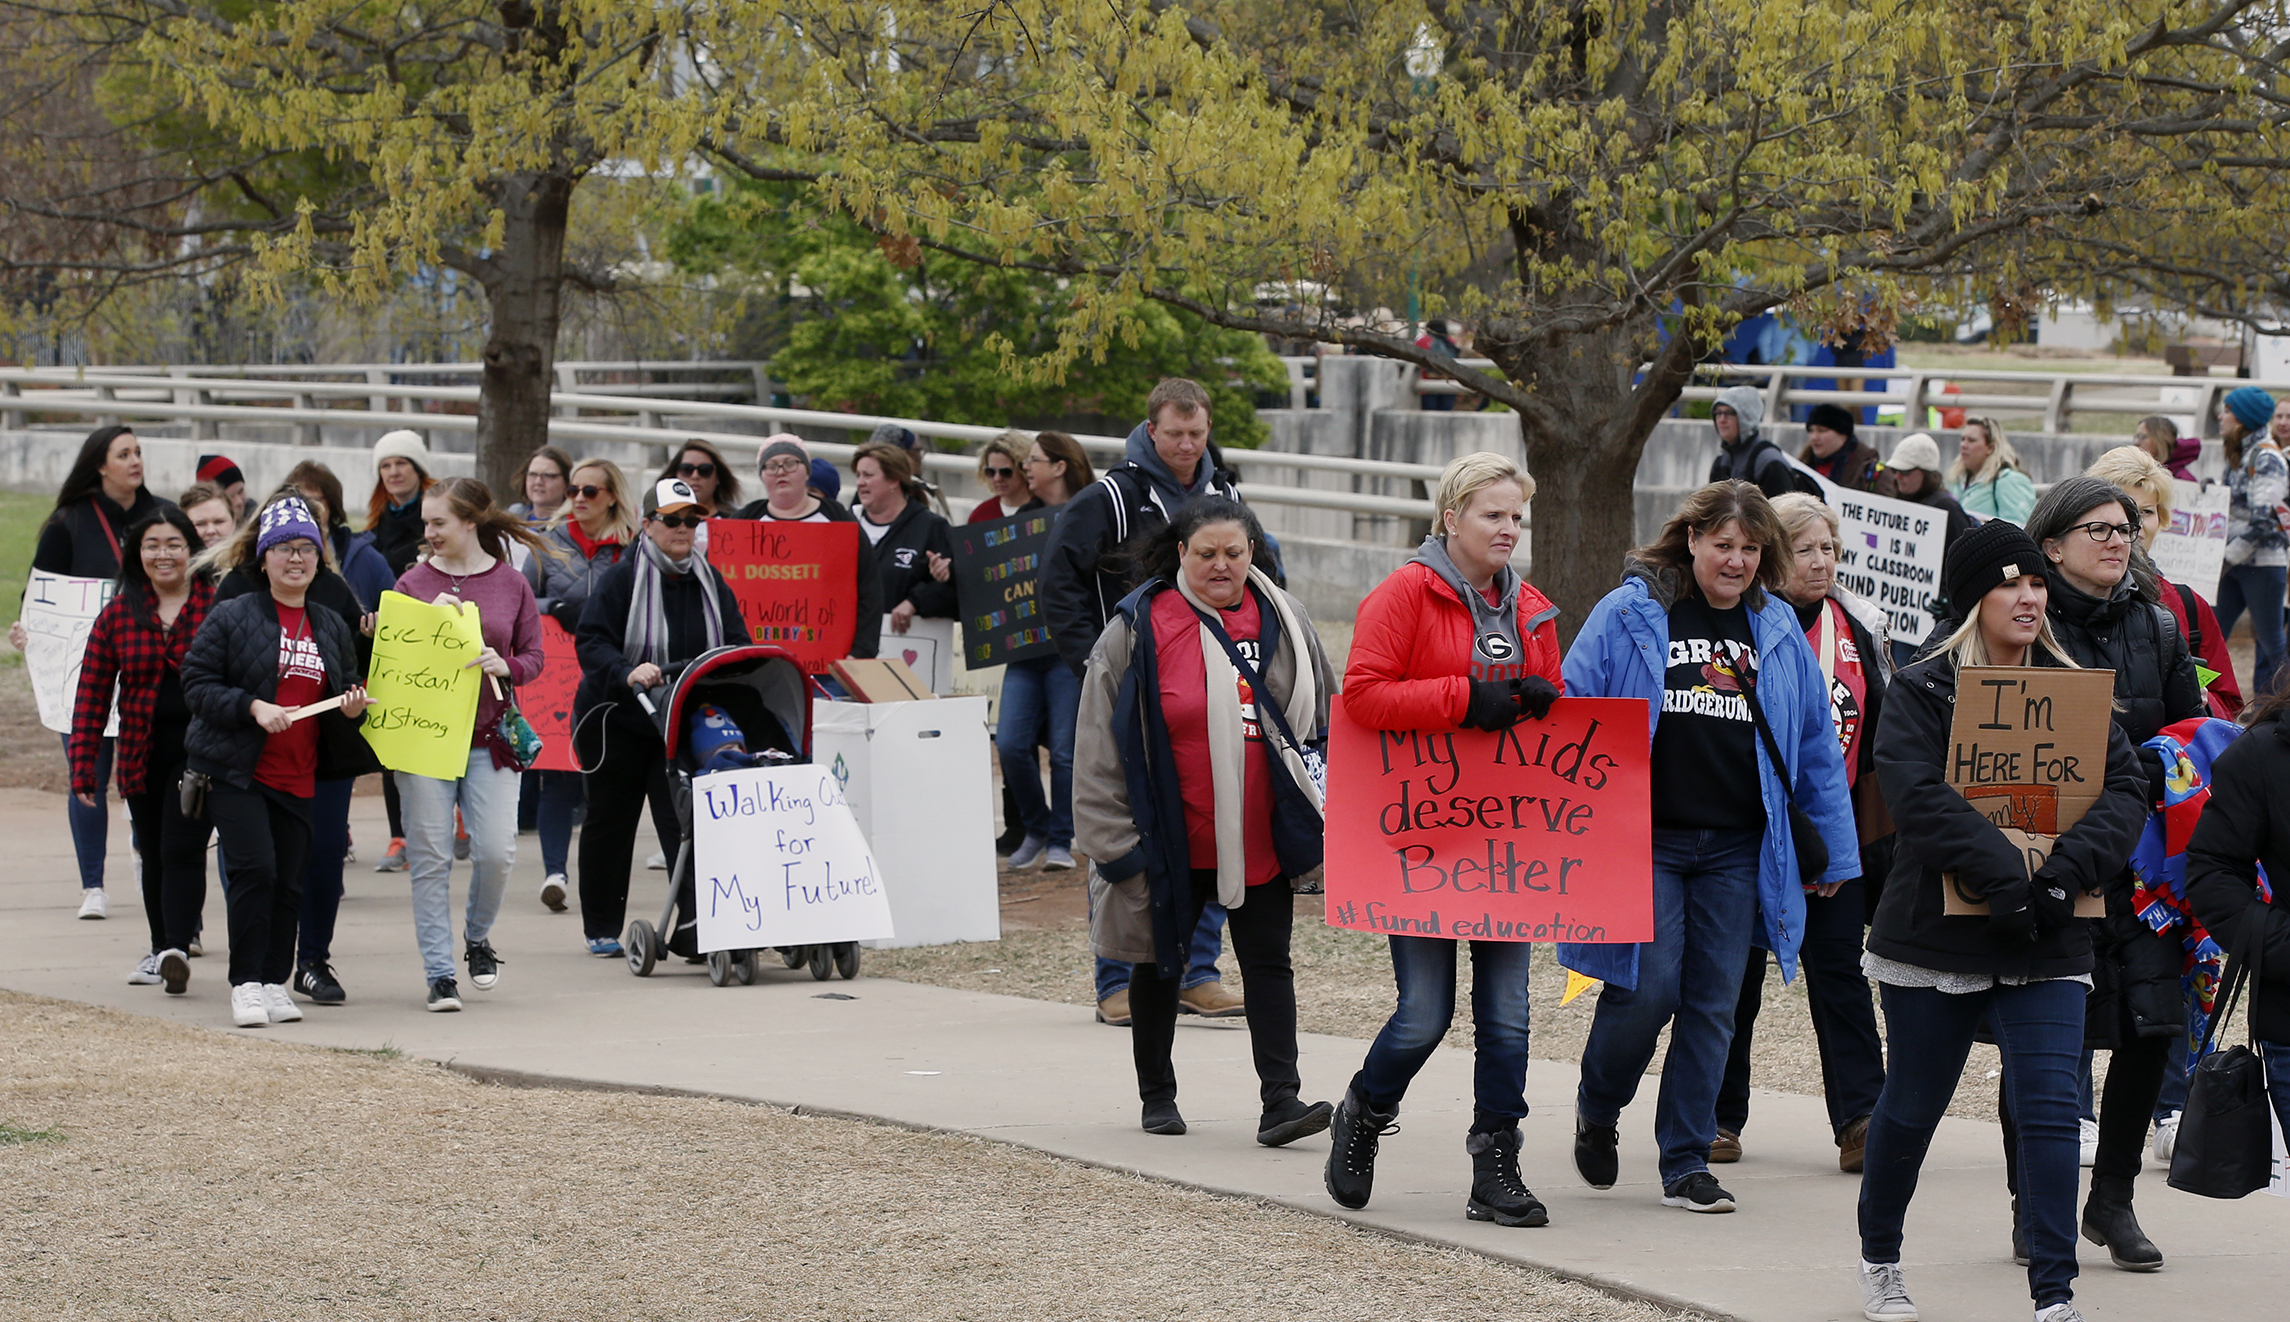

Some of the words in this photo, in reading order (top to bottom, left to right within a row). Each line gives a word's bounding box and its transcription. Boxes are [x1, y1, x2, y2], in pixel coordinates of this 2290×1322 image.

[1842, 503, 1862, 520] THE
[1867, 508, 1910, 532] FUTURE
[1915, 519, 1929, 536] OF
[745, 523, 791, 560] the
[1890, 538, 1901, 554] IS
[1905, 542, 1916, 558] IN
[745, 564, 820, 580] DOSSETT
[1841, 549, 1858, 565] MY
[1867, 555, 1933, 584] CLASSROOM
[34, 577, 56, 605] I
[1836, 571, 1875, 597] FUND
[1881, 582, 1930, 612] PUBLIC
[818, 599, 836, 625] of
[431, 621, 469, 650] for
[372, 652, 460, 692] Tristan!
[1843, 709, 1858, 717] 1904
[1979, 679, 2054, 731] I'm
[1379, 729, 1460, 795] My
[1493, 715, 1619, 790] Kids
[1954, 743, 2021, 783] HERE
[2033, 743, 2085, 784] FOR
[705, 780, 815, 825] Walking
[1379, 780, 1594, 836] deserve
[775, 829, 816, 855] for
[1393, 838, 1583, 895] Better
[709, 874, 761, 931] My
[782, 856, 877, 911] Future!
[1452, 912, 1606, 941] education
